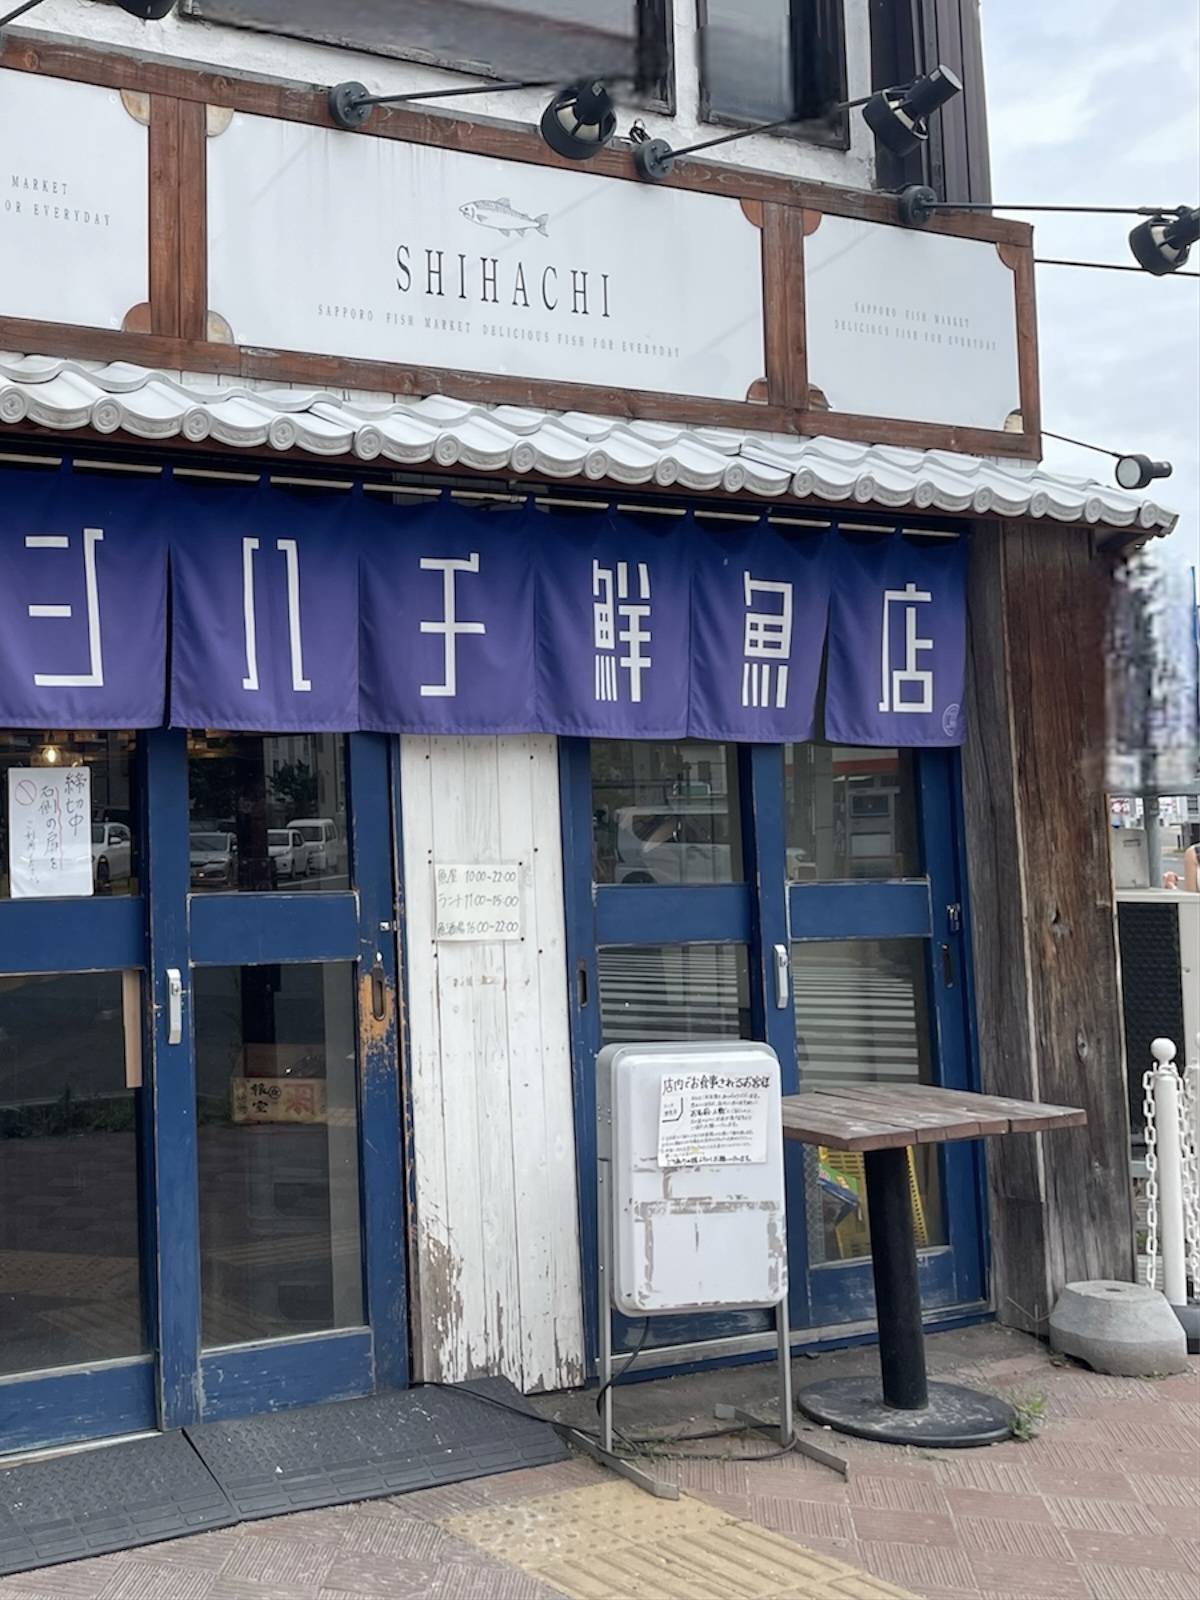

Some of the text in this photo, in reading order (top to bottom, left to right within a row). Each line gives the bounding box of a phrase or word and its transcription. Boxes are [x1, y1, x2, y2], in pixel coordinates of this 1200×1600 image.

[11, 175, 69, 196] MARKET
[33, 203, 112, 227] EVERYDAY
[395, 244, 611, 318] SHIHACHI
[317, 304, 681, 359] SAPPORO FISH MARKET DELICIOUS FISH FOR EVERYDAY
[854, 302, 897, 318] SAPPORO
[905, 309, 927, 323] FISH
[896, 328, 918, 341] FISH
[24, 527, 934, 713] シハチ鮮魚店
[64, 772, 88, 837] 締切中
